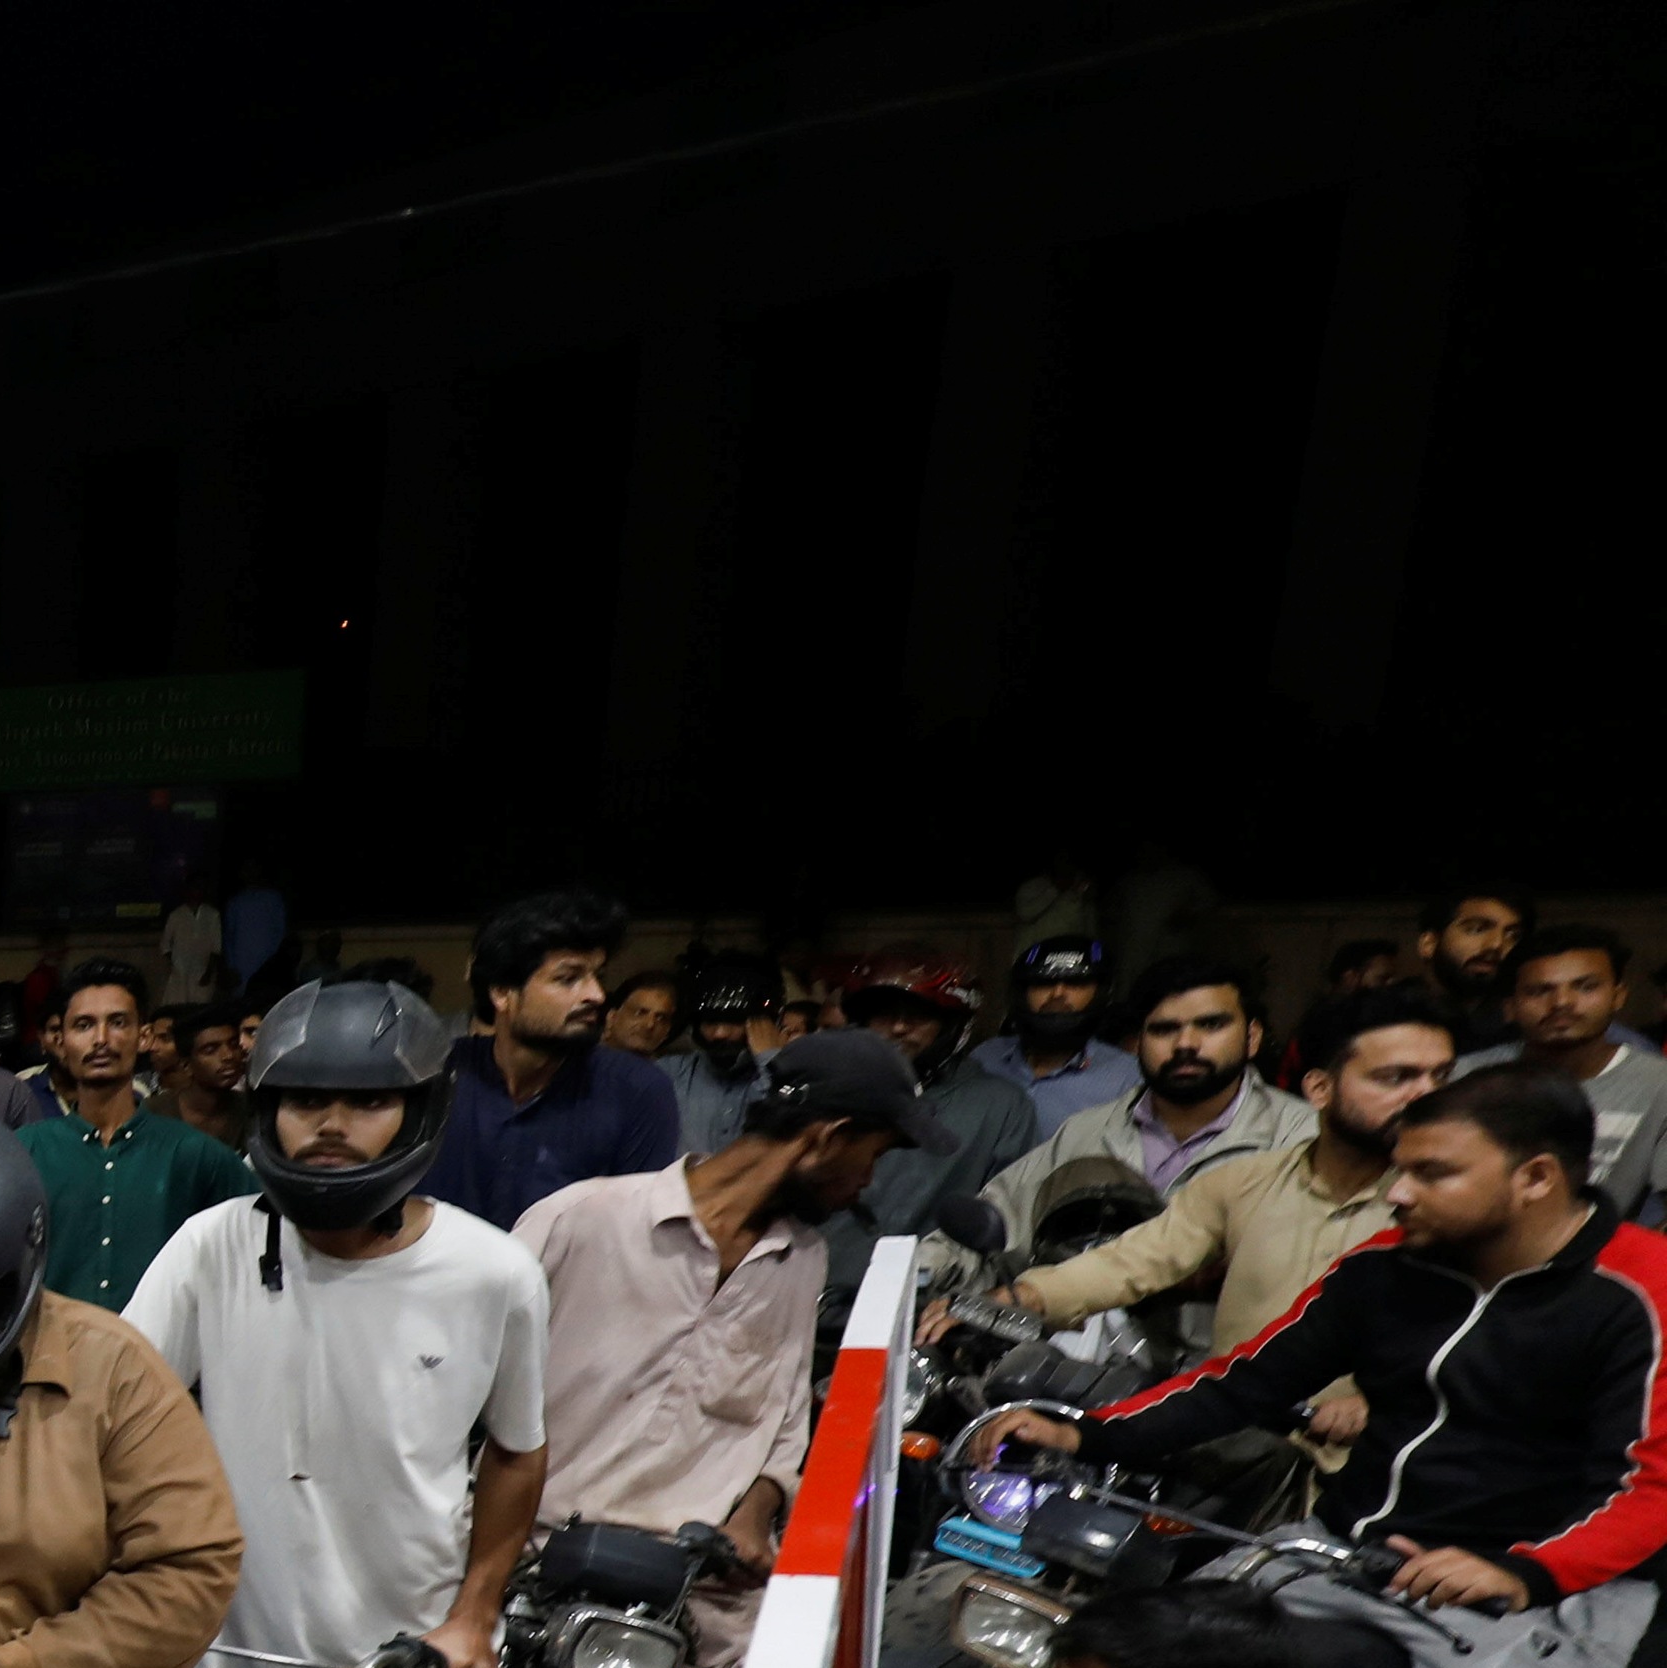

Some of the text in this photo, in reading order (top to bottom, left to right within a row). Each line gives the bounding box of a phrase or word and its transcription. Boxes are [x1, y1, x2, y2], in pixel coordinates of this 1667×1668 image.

[48, 687, 191, 713] Office of the
[74, 715, 149, 736] Muslim
[159, 707, 274, 733] University
[33, 747, 122, 767] Association
[126, 744, 145, 762] of
[152, 740, 219, 761] Pakistan
[227, 736, 291, 756] Karachi
